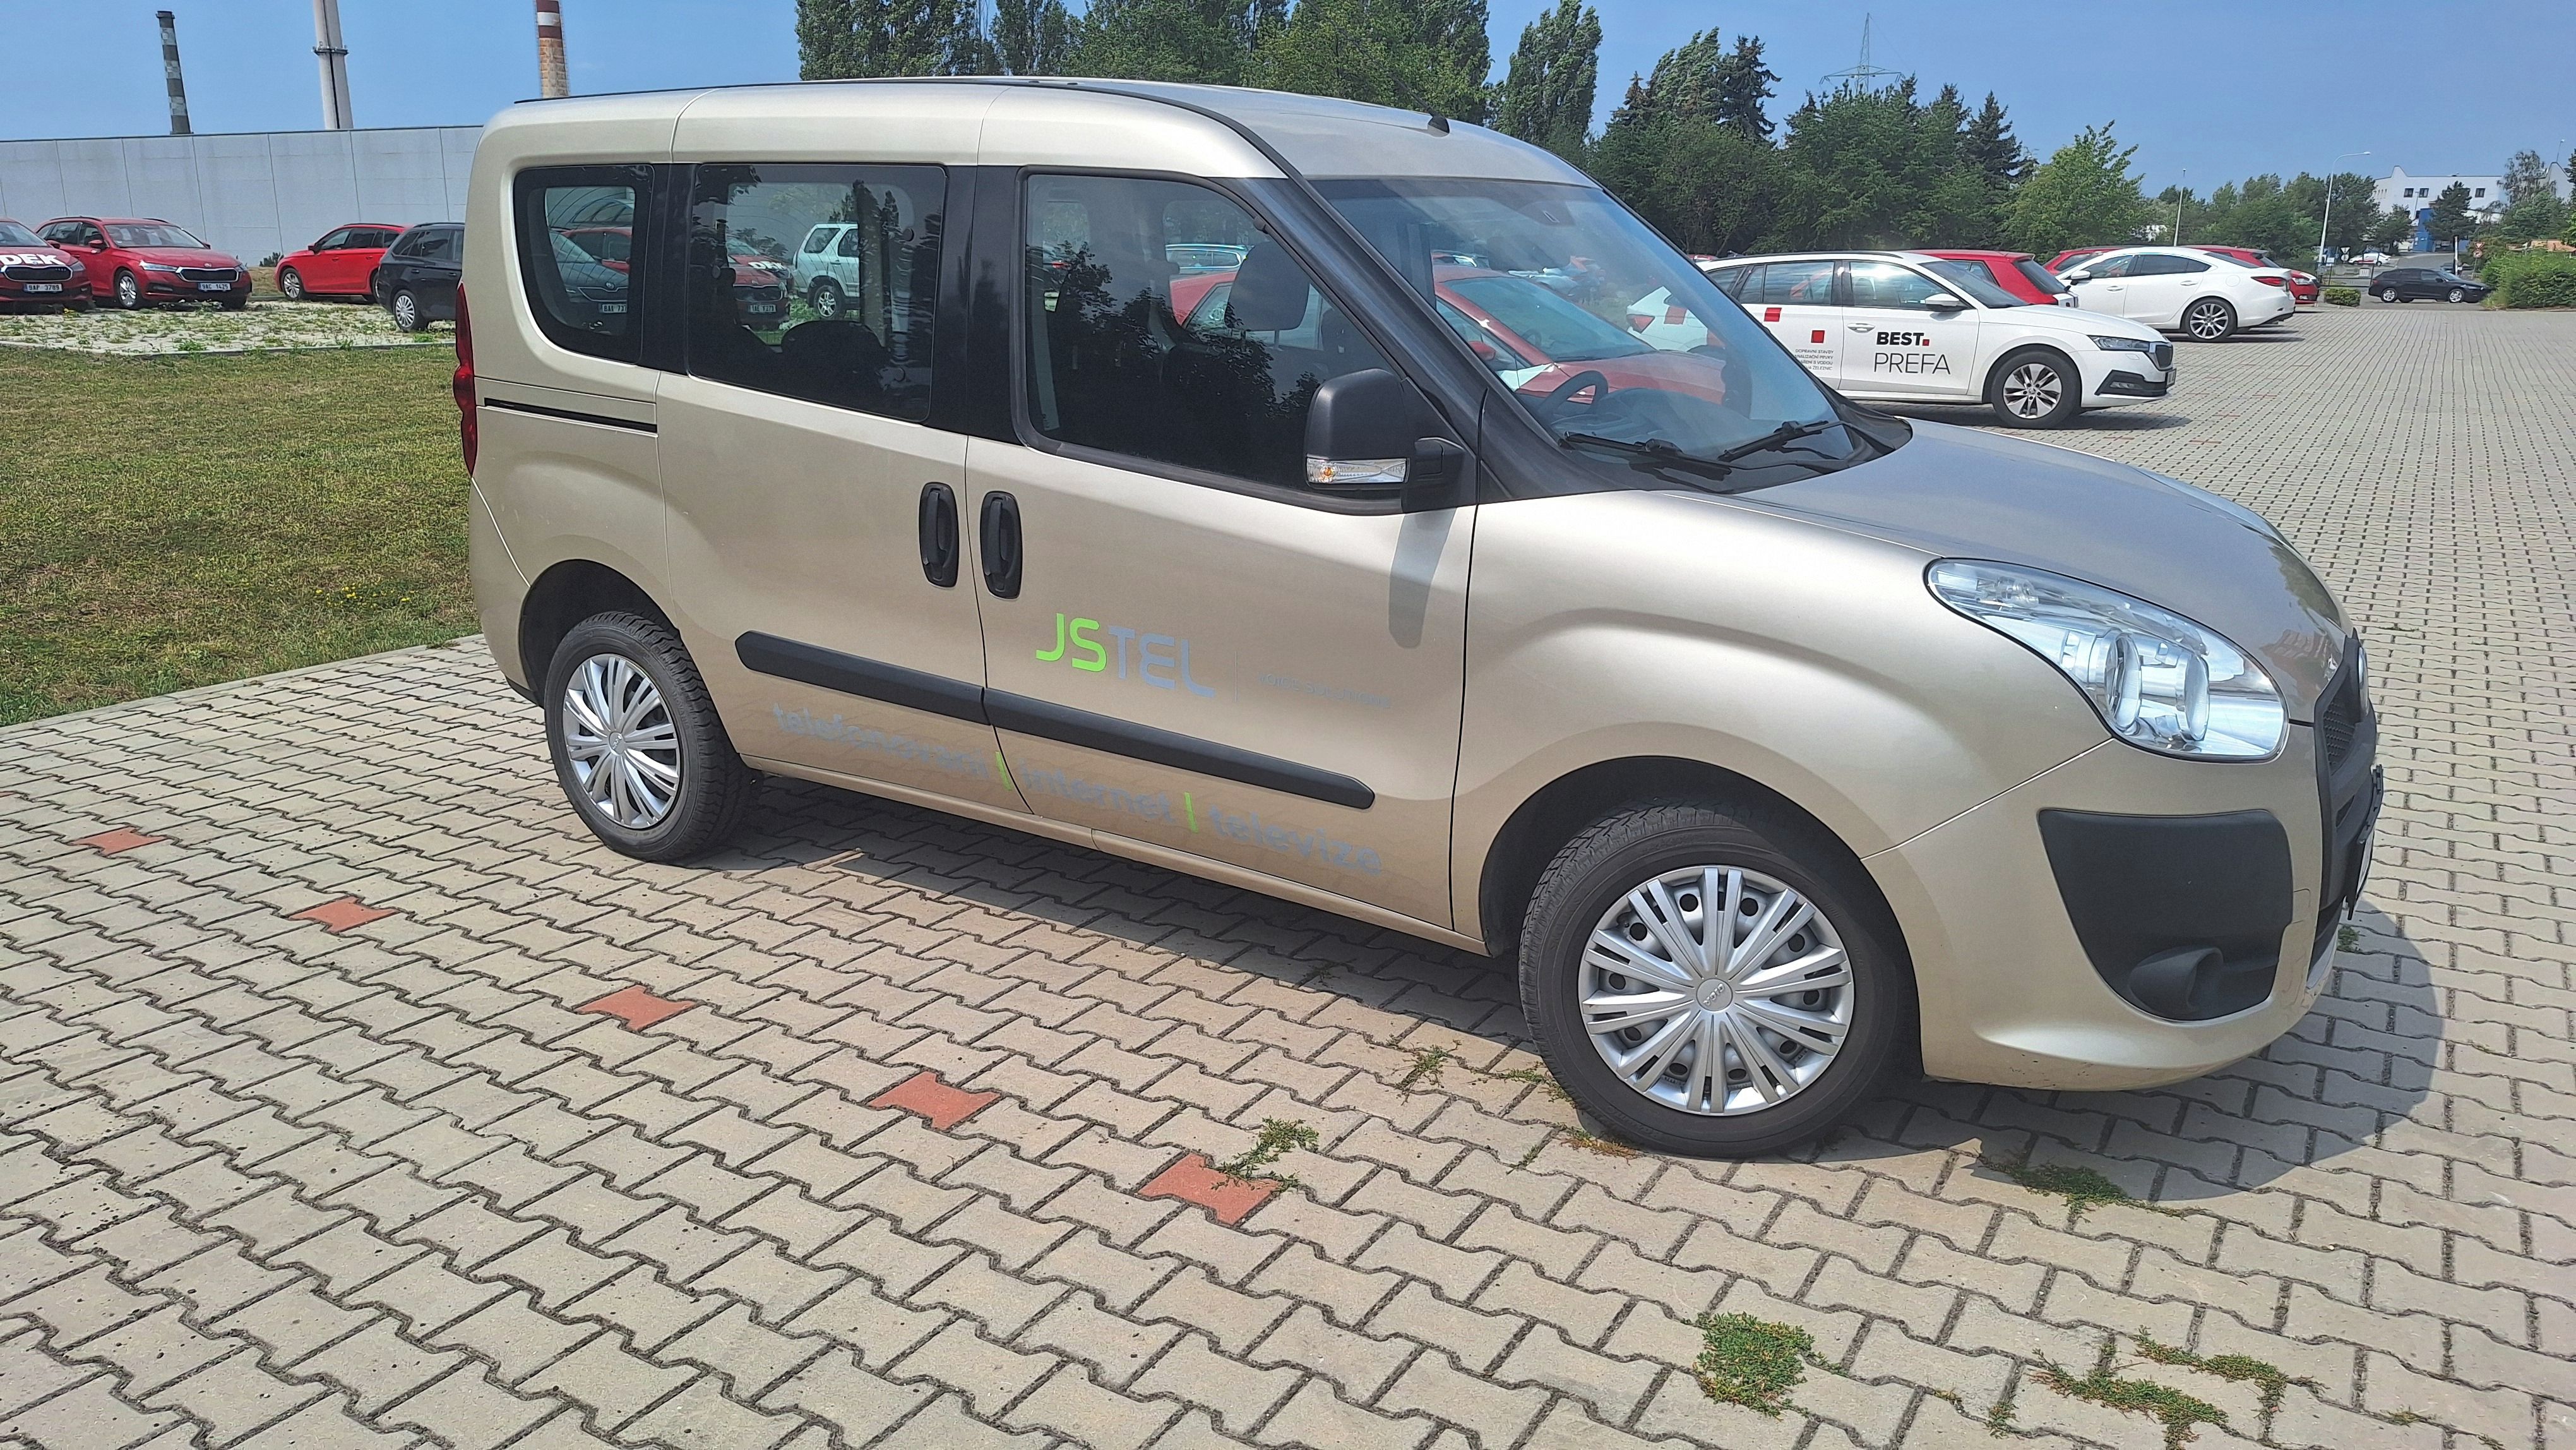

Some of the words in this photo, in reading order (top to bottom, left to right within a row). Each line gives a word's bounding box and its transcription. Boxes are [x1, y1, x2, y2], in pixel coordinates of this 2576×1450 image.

[1874, 352, 1951, 374] PREFA
[1036, 613, 1215, 698] JSTEL
[1019, 758, 1177, 824] internet
[1208, 805, 1382, 876] televize
